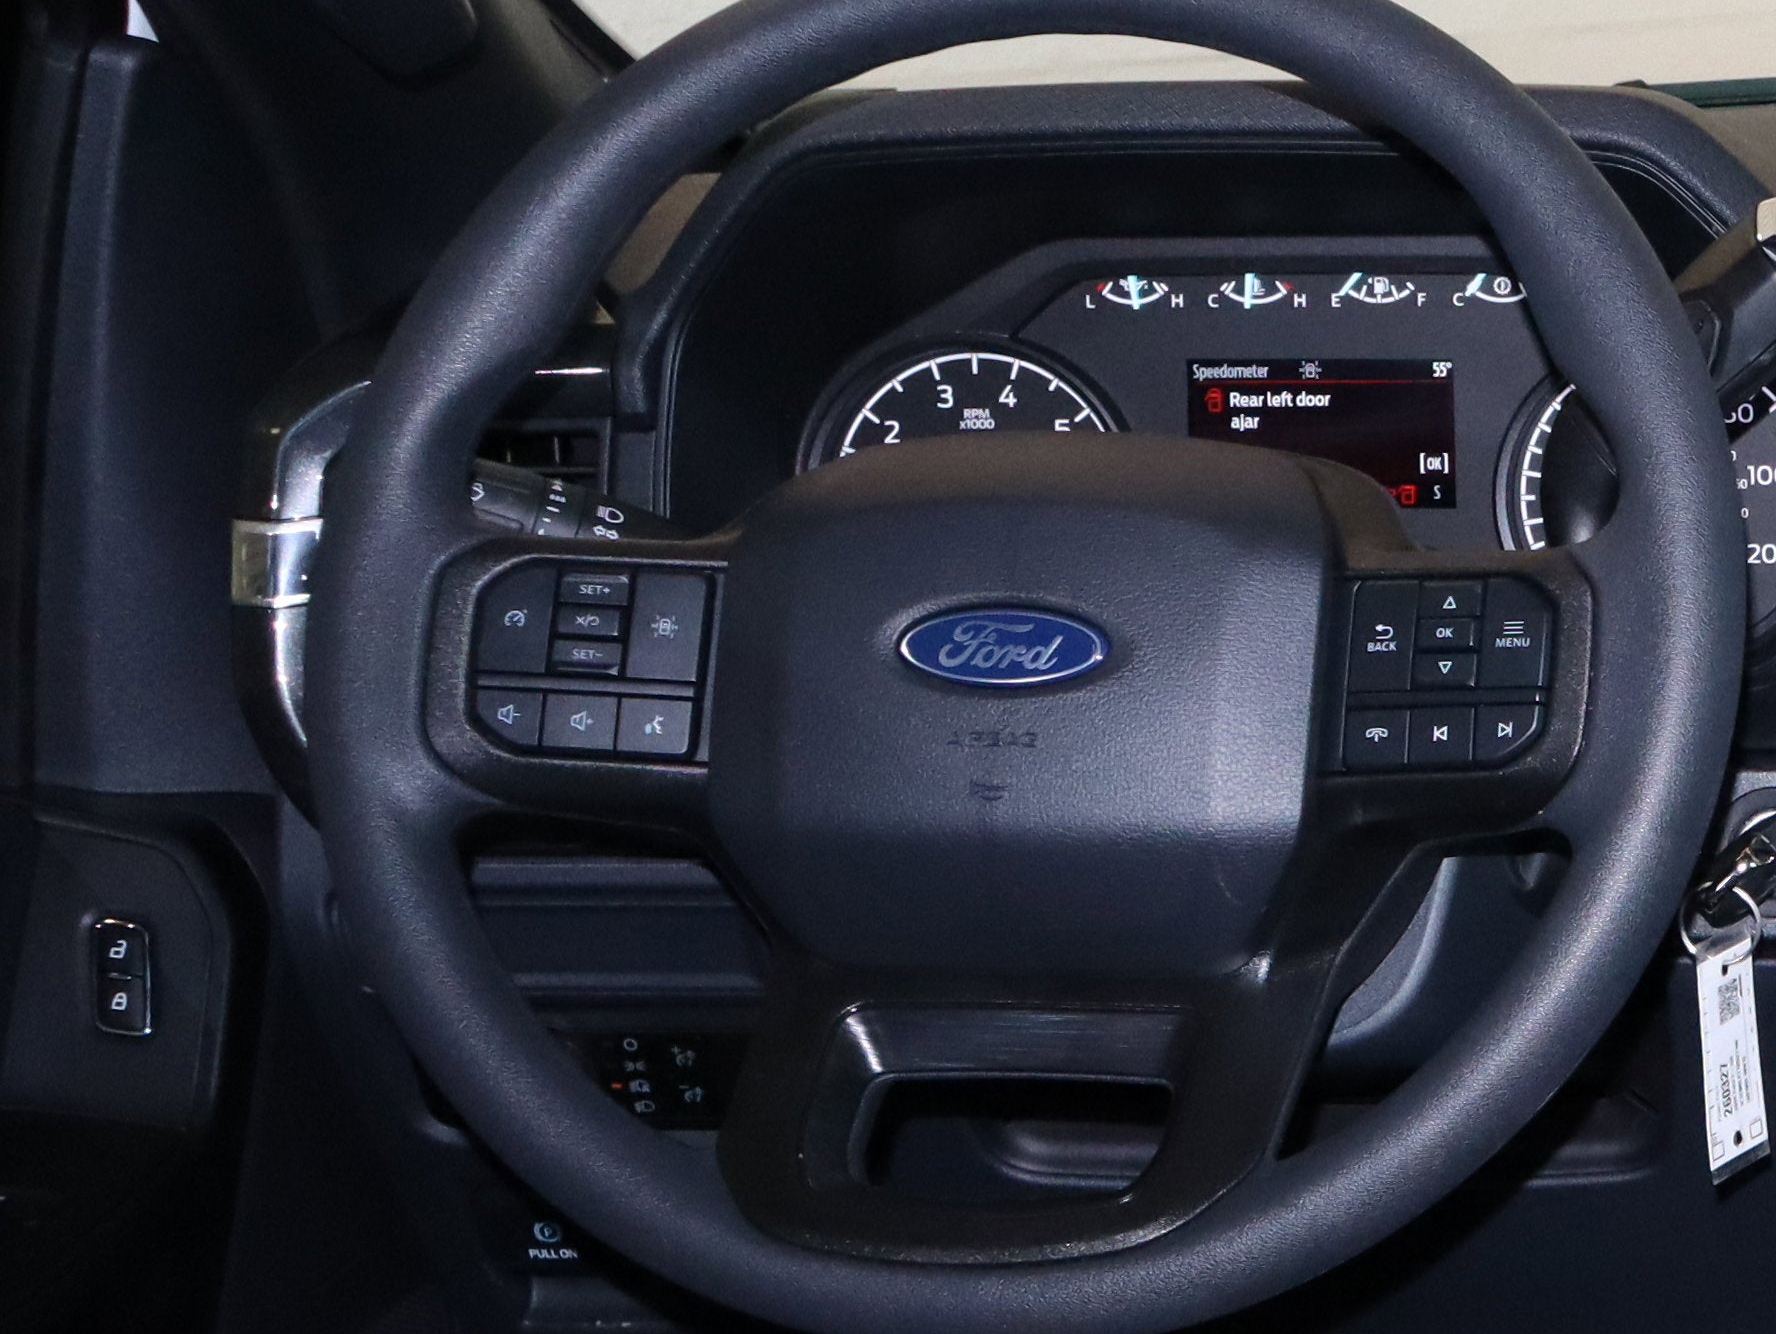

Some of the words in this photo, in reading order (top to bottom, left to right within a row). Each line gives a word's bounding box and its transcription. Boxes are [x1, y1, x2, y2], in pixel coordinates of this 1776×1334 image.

[1085, 294, 1096, 309] L
[1171, 294, 1184, 308] H
[1207, 293, 1219, 308] C
[1293, 293, 1307, 308] H
[1331, 293, 1342, 308] E
[1417, 292, 1426, 307] F
[1452, 292, 1465, 307] C
[1192, 363, 1269, 380] Speedometer
[936, 385, 954, 409] 3
[998, 385, 1018, 407] 4
[1229, 391, 1265, 408] Rear
[1266, 391, 1294, 408] left
[1296, 391, 1331, 407] door
[963, 408, 990, 419] RPM
[959, 419, 995, 430] x1000
[1230, 413, 1260, 431] ajar
[884, 421, 901, 444] 2
[1433, 485, 1441, 500] S
[579, 584, 611, 595] SET+
[1435, 628, 1454, 638] OK
[938, 620, 1064, 670] Ford
[1367, 641, 1397, 652] BACK
[1495, 637, 1530, 648] MENU
[528, 1248, 559, 1259] PULL
[559, 1248, 578, 1259] ON
